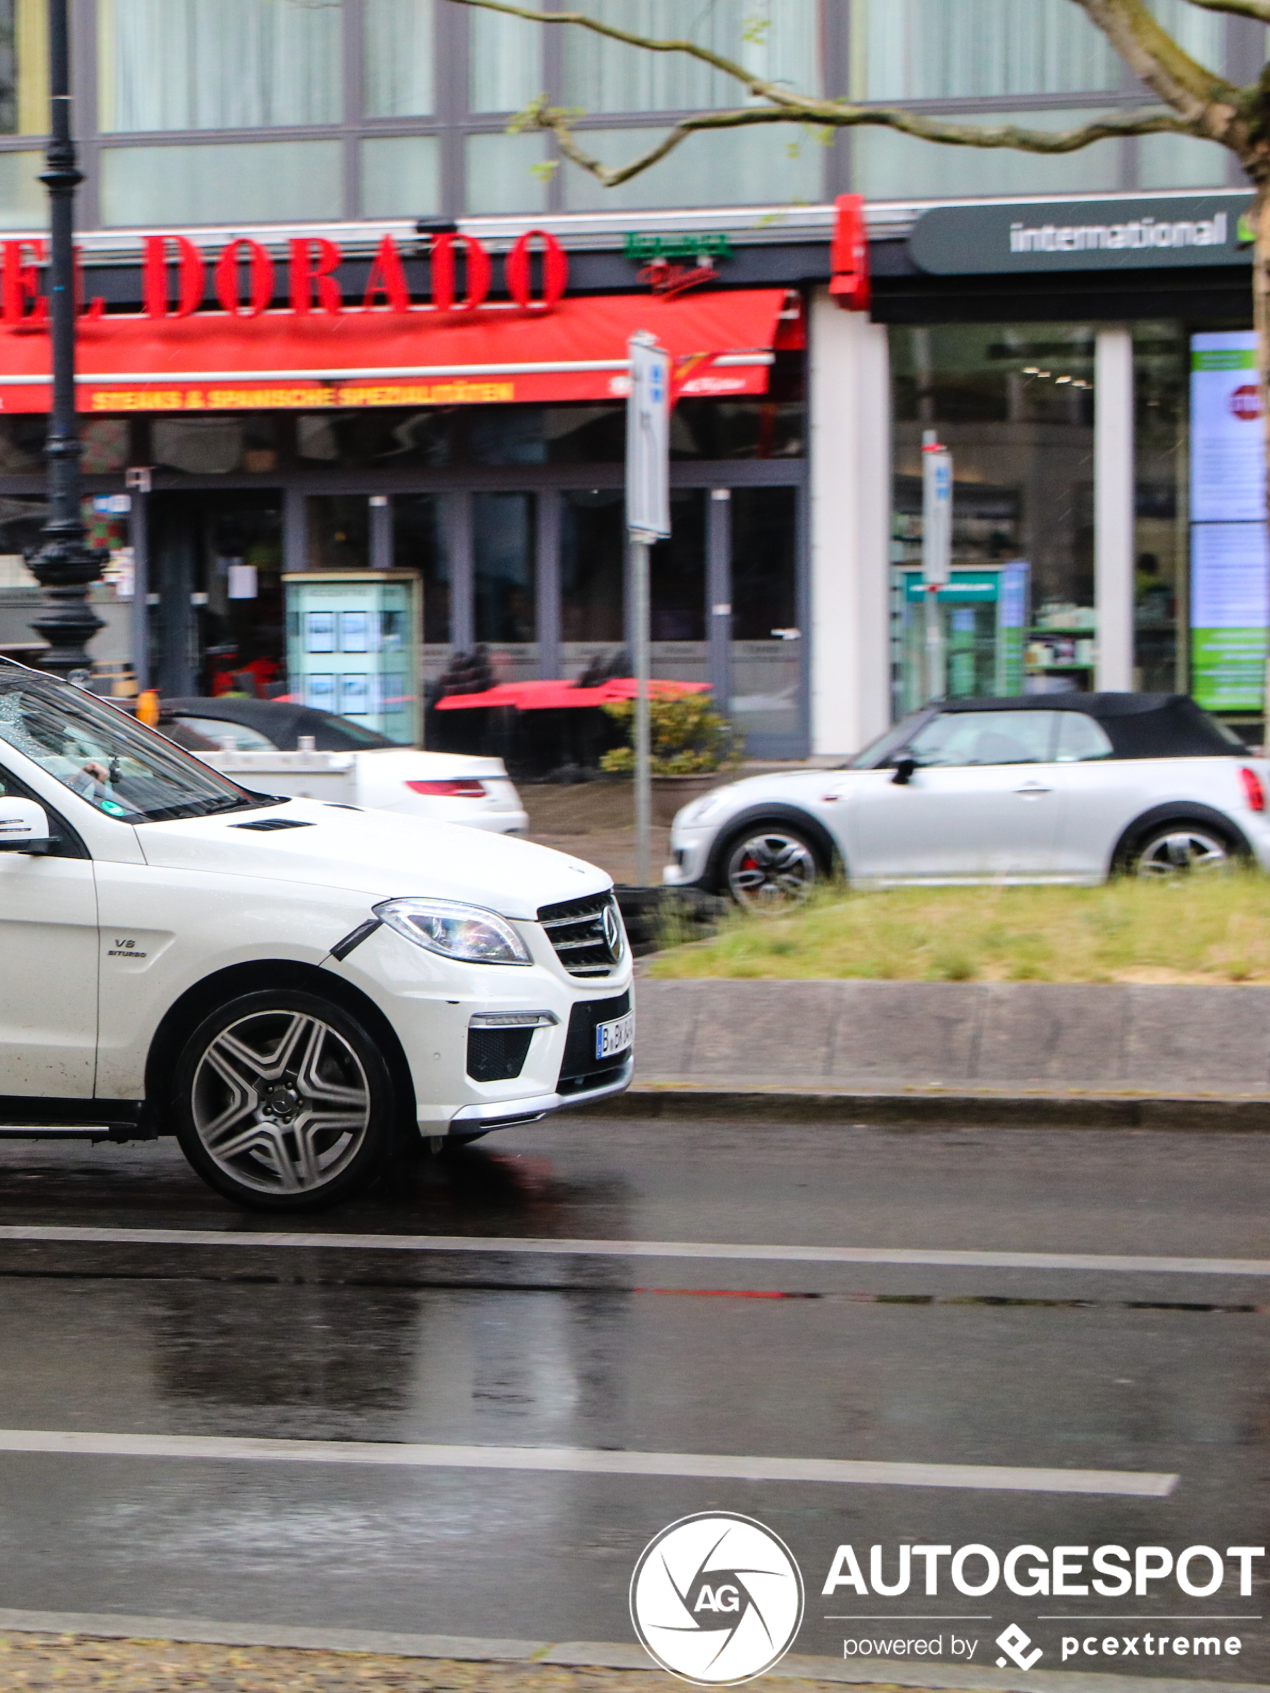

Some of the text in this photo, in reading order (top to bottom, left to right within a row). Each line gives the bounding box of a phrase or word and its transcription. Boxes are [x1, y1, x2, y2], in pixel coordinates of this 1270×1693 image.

[1010, 212, 1227, 252] international
[142, 230, 569, 319] DORADO
[91, 381, 515, 410] STEAKS & SPANISCHE SPEZIALITÄTEN
[107, 949, 147, 958] BITURBO
[115, 938, 136, 948] V8
